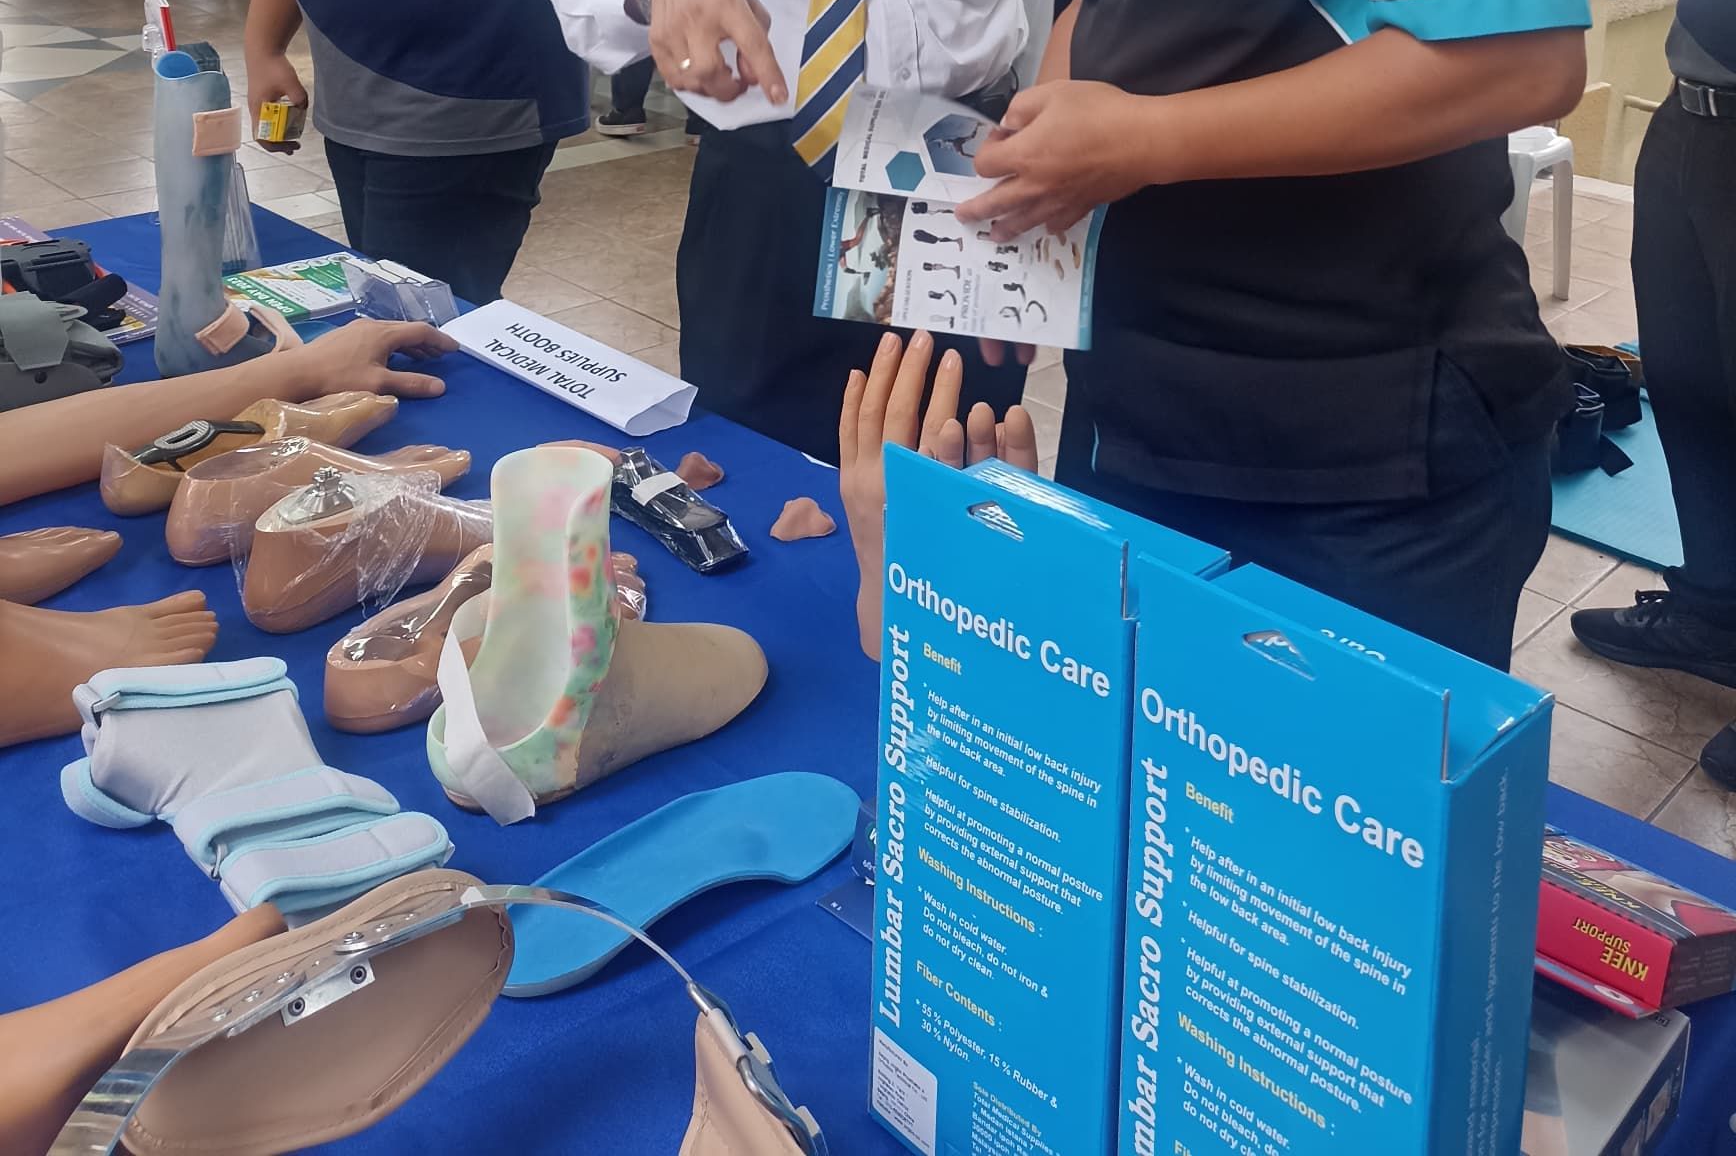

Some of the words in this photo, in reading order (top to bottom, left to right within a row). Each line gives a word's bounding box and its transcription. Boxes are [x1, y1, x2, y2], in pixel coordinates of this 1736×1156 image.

[822, 264, 834, 310] Prosthetics
[827, 231, 837, 258] Lower
[266, 299, 294, 314] OPEN
[505, 322, 561, 354] BOOTH
[484, 338, 551, 376] MEDICAL
[546, 371, 596, 400] TOTAL
[555, 349, 628, 383] SUPPLIES
[888, 562, 1031, 660] Orthopedic
[1040, 640, 1110, 697] Care
[923, 642, 961, 675] Benefit
[884, 624, 915, 774] Support
[927, 689, 948, 710] Help
[948, 704, 970, 721] after
[971, 714, 980, 728] in
[982, 723, 994, 735] an
[995, 728, 1023, 751] initial
[1024, 743, 1043, 761] low
[1043, 753, 1069, 775] back
[1070, 768, 1101, 794] injury
[927, 724, 941, 739] the
[942, 731, 958, 748] low
[959, 742, 981, 762] back
[982, 758, 1005, 777] area.
[927, 706, 939, 722] by
[939, 713, 973, 743] limiting
[974, 735, 1024, 769] movement
[1025, 764, 1037, 775] of
[1038, 768, 1054, 785] the
[1055, 780, 1085, 802] spine
[1086, 794, 1097, 808] in
[1141, 687, 1322, 814] Orthopedic
[1334, 794, 1424, 868] Care
[882, 781, 906, 884] Sacro
[925, 755, 956, 781] Helpful
[958, 774, 971, 790] for
[972, 786, 998, 807] spine
[999, 802, 1060, 842] stabilization.
[1135, 757, 1174, 928] Support
[1185, 781, 1233, 823] Benefit
[924, 787, 955, 814] Helpful
[956, 810, 966, 822] at
[966, 816, 1015, 854] promoting
[1016, 846, 1023, 856] a
[1025, 851, 1061, 877] normal
[1061, 872, 1103, 901] posture
[924, 803, 935, 819] by
[936, 813, 978, 848] providing
[979, 841, 1018, 870] external
[1019, 865, 1059, 894] support
[1060, 887, 1081, 907] that
[924, 822, 959, 850] corrects
[960, 844, 975, 861] the
[976, 856, 1021, 889] abnormal
[1022, 884, 1063, 914] posture.
[918, 845, 963, 890] Washing
[966, 878, 1035, 933] Instructions
[924, 890, 947, 914] Wash
[948, 909, 957, 921] in
[958, 917, 979, 936] cold
[980, 931, 1006, 955] water.
[1190, 873, 1207, 893] the
[1209, 885, 1229, 907] low
[1230, 899, 1259, 926] back
[1260, 921, 1289, 946] area.
[1190, 854, 1205, 873] by
[1206, 864, 1248, 902] limiting
[1249, 894, 1313, 940] movement
[1314, 934, 1329, 948] of
[1330, 942, 1351, 962] the
[1353, 958, 1390, 985] spine
[1392, 978, 1406, 995] in
[1191, 835, 1216, 861] Help
[1217, 855, 1245, 877] after
[1246, 870, 1258, 886] in
[1259, 881, 1275, 897] an
[1277, 889, 1312, 918] initial
[1313, 910, 1336, 933] low
[1338, 925, 1370, 953] back
[1372, 946, 1412, 979] injury
[879, 888, 903, 1028] Lumbar
[922, 923, 934, 937] do
[935, 933, 950, 949] not
[951, 944, 966, 961] dry
[967, 956, 994, 979] clean.
[922, 906, 935, 922] Do
[936, 918, 952, 934] not
[952, 927, 984, 957] bleach,
[986, 952, 999, 966] do
[1000, 962, 1017, 978] not
[1018, 972, 1038, 992] iron
[1040, 985, 1048, 998] &
[1188, 909, 1227, 944] Helpful
[1228, 937, 1246, 955] for
[1247, 951, 1280, 979] spine
[1281, 974, 1358, 1029] stabilization.
[1573, 917, 1632, 953] SUPPORT
[1600, 946, 1649, 982] KNEE
[916, 959, 943, 988] Fiber
[945, 982, 995, 1026] Contents
[1131, 935, 1162, 1052] Sacro
[1186, 946, 1226, 981] Helpful
[1227, 977, 1239, 991] at
[1240, 986, 1301, 1034] promoting
[1303, 1027, 1311, 1039] a
[1313, 1034, 1359, 1069] normal
[1360, 1064, 1412, 1104] posture
[1186, 964, 1200, 984] by
[1200, 978, 1254, 1023] providing
[1256, 1016, 1304, 1053] external
[1306, 1049, 1356, 1088] support
[1358, 1081, 1384, 1107] that
[921, 1018, 932, 1033] 30
[933, 1027, 941, 1041] %
[942, 1035, 970, 1061] Nylon.
[921, 1003, 932, 1017] 55
[933, 1011, 941, 1025] %
[943, 1019, 986, 1059] Polyester,
[989, 1053, 1000, 1067] 15
[1001, 1061, 1010, 1075] %
[1012, 1069, 1048, 1100] Rubber
[1049, 1096, 1057, 1109] &
[1178, 1011, 1235, 1068] Washing
[1239, 1055, 1326, 1129] Instructions
[1185, 985, 1230, 1022] corrects
[1232, 1016, 1251, 1036] the
[1252, 1032, 1308, 1076] abnormal
[1310, 1071, 1361, 1113] posture.
[974, 1092, 990, 1108] Total
[992, 1106, 1020, 1131] Medical
[1128, 1054, 1158, 1156] mbar
[1183, 1080, 1198, 1100] Do
[1200, 1096, 1219, 1116] not
[1220, 1108, 1260, 1149] bleach,
[1183, 1100, 1197, 1117] do
[1199, 1113, 1218, 1133] not
[1219, 1128, 1238, 1149] dry
[1184, 1062, 1214, 1092] Wash
[1215, 1086, 1227, 1103] in
[1229, 1099, 1254, 1123] cold
[1256, 1118, 1289, 1149] water.
